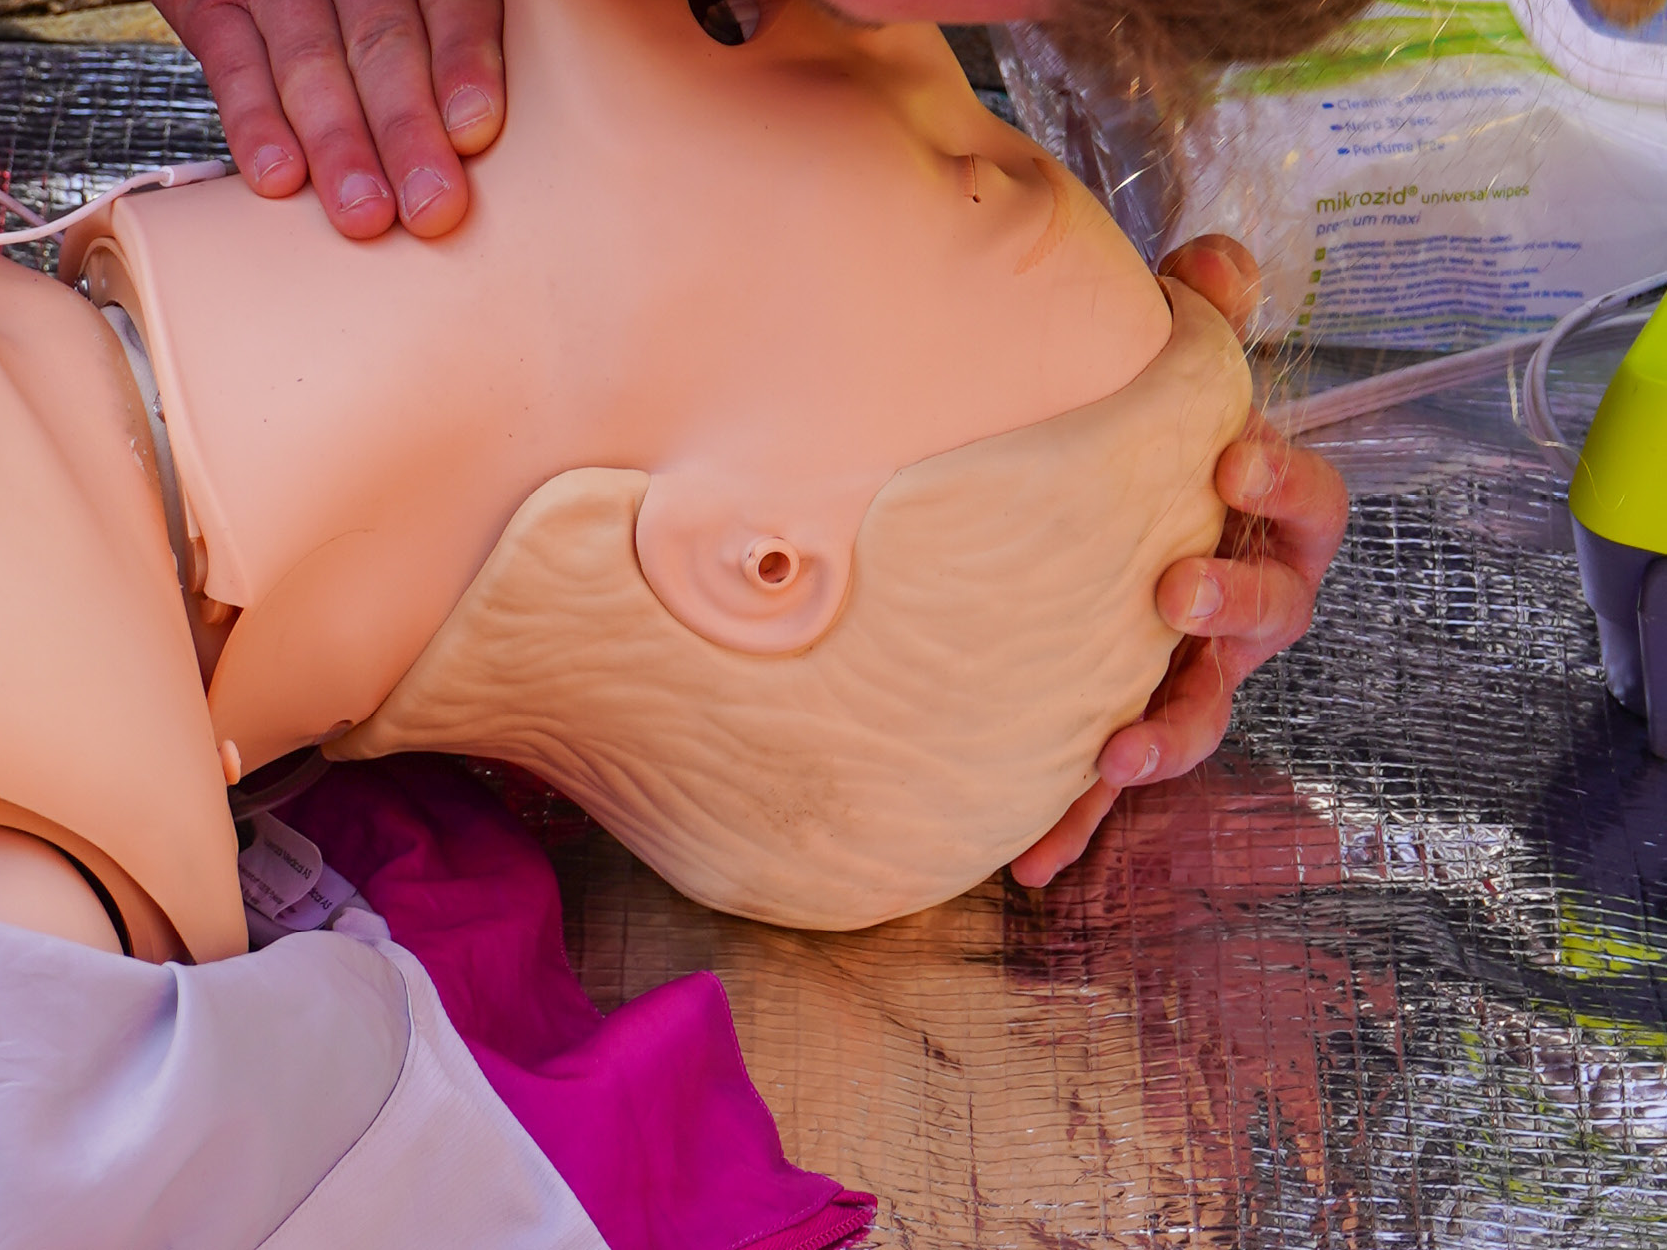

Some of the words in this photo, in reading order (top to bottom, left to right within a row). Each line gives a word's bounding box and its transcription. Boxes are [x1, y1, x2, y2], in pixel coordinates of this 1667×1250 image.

[1352, 141, 1413, 157] Perfume
[1421, 186, 1488, 206] universal
[1491, 183, 1530, 200] wipes
[1315, 214, 1377, 237] preum
[1381, 210, 1422, 227] maxi
